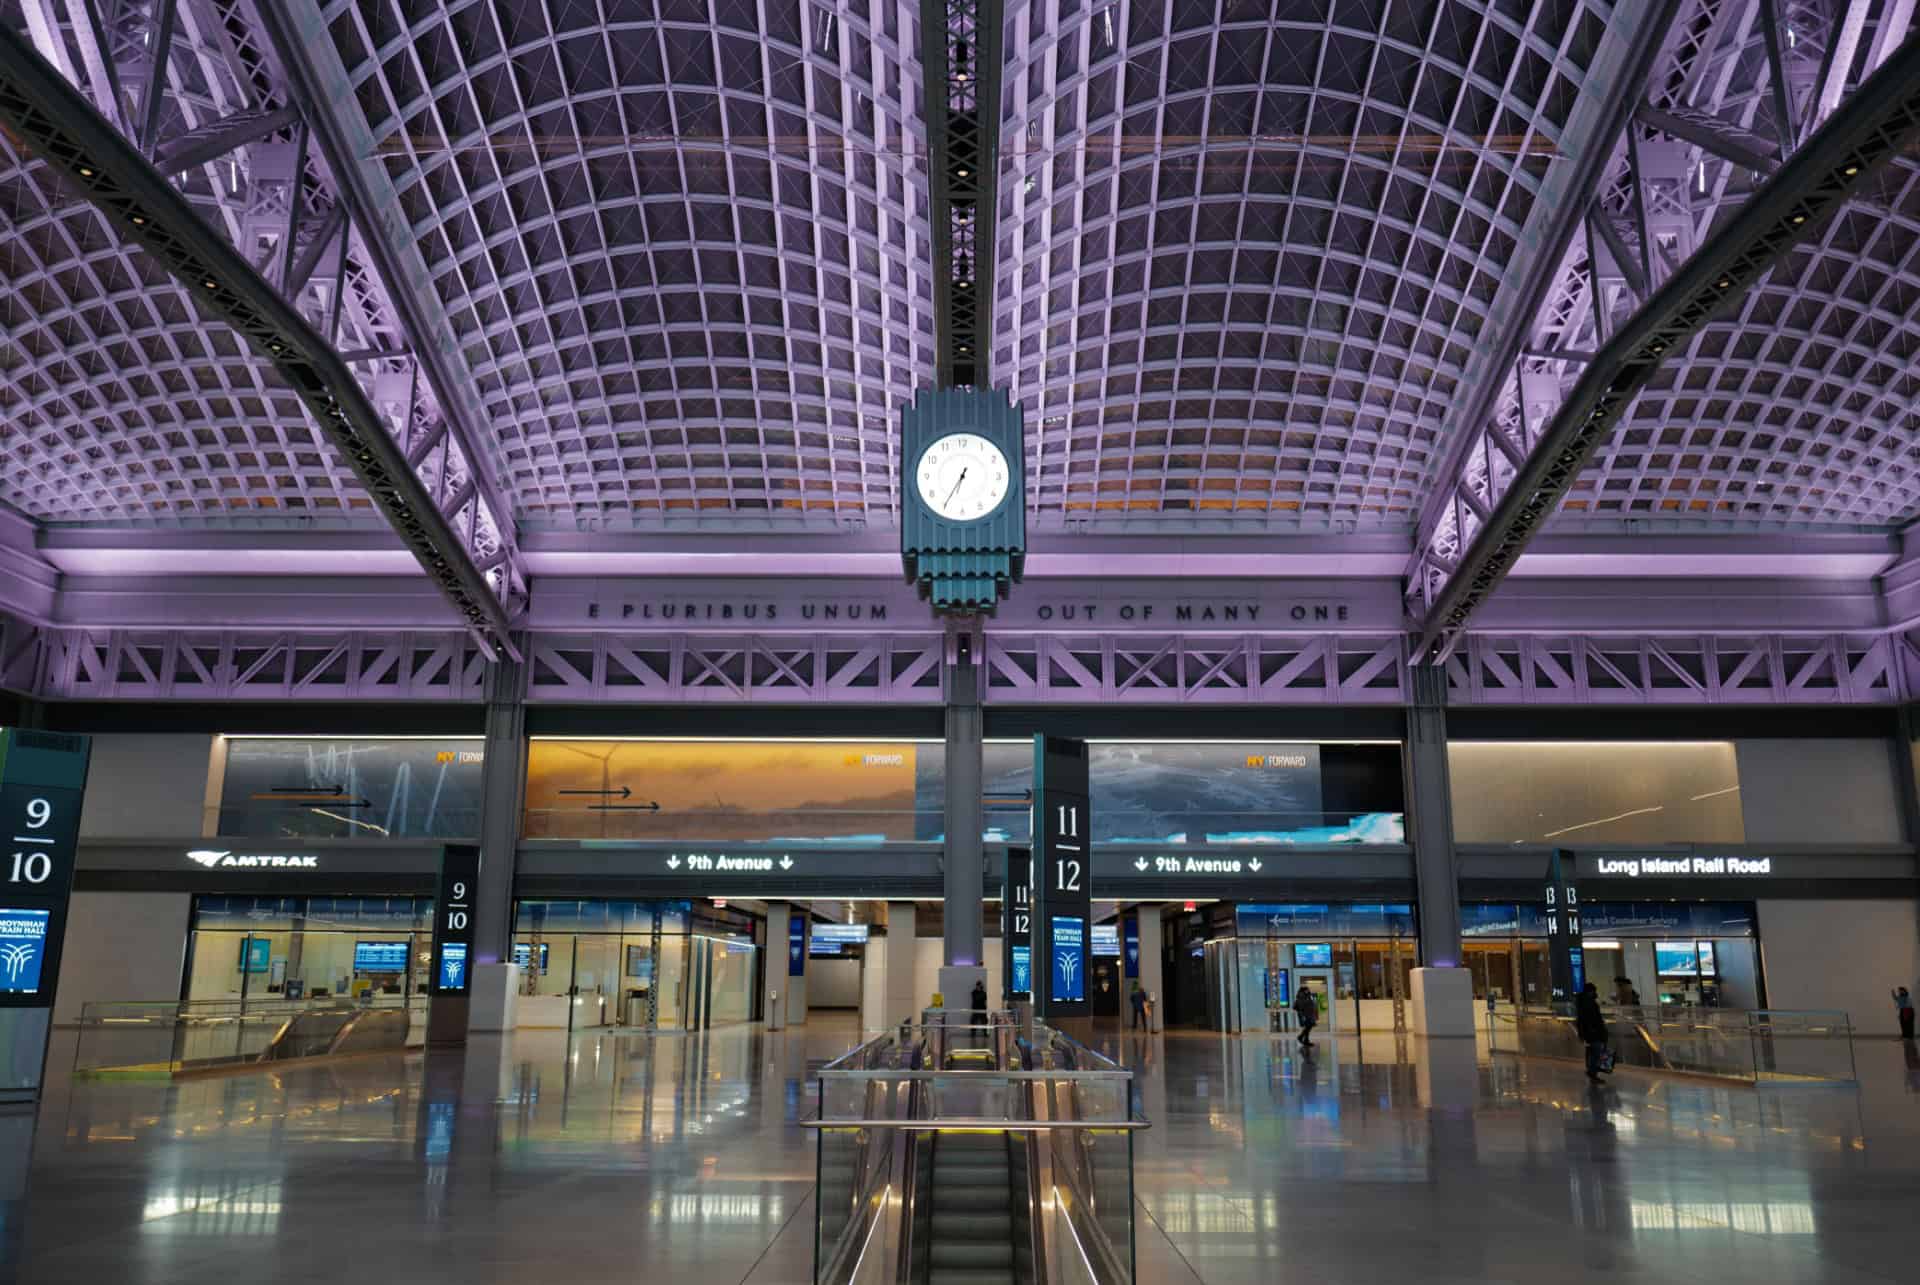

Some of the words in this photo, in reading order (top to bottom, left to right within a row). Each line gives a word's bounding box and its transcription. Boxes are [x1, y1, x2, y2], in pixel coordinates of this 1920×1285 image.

[588, 604, 599, 619] E
[622, 604, 777, 619] PLURIBUS
[801, 604, 887, 619] UNUM
[1037, 604, 1098, 620] OUT
[1119, 604, 1154, 620] OF
[1175, 604, 1261, 620] MANY
[1290, 604, 1349, 620] ONE
[26, 798, 51, 828] 9
[1057, 805, 1078, 837] 11
[8, 852, 52, 883] 10
[221, 855, 318, 867] AMTRAK
[687, 854, 713, 870] 9th
[715, 854, 773, 870] Avenue
[1155, 856, 1181, 872] 9th
[1184, 856, 1241, 872] Avenue
[1598, 858, 1639, 877] Long
[1641, 858, 1690, 873] Island
[1693, 858, 1724, 873] Rail
[1727, 858, 1770, 873] Road
[1055, 859, 1081, 891] 12
[453, 882, 465, 899] 9
[1016, 885, 1028, 904] 11
[1546, 887, 1555, 904] 13
[1566, 887, 1577, 905] 13
[447, 911, 468, 930] 10
[1015, 914, 1029, 933] 12
[1547, 916, 1557, 935] 14
[1568, 916, 1579, 935] 14
